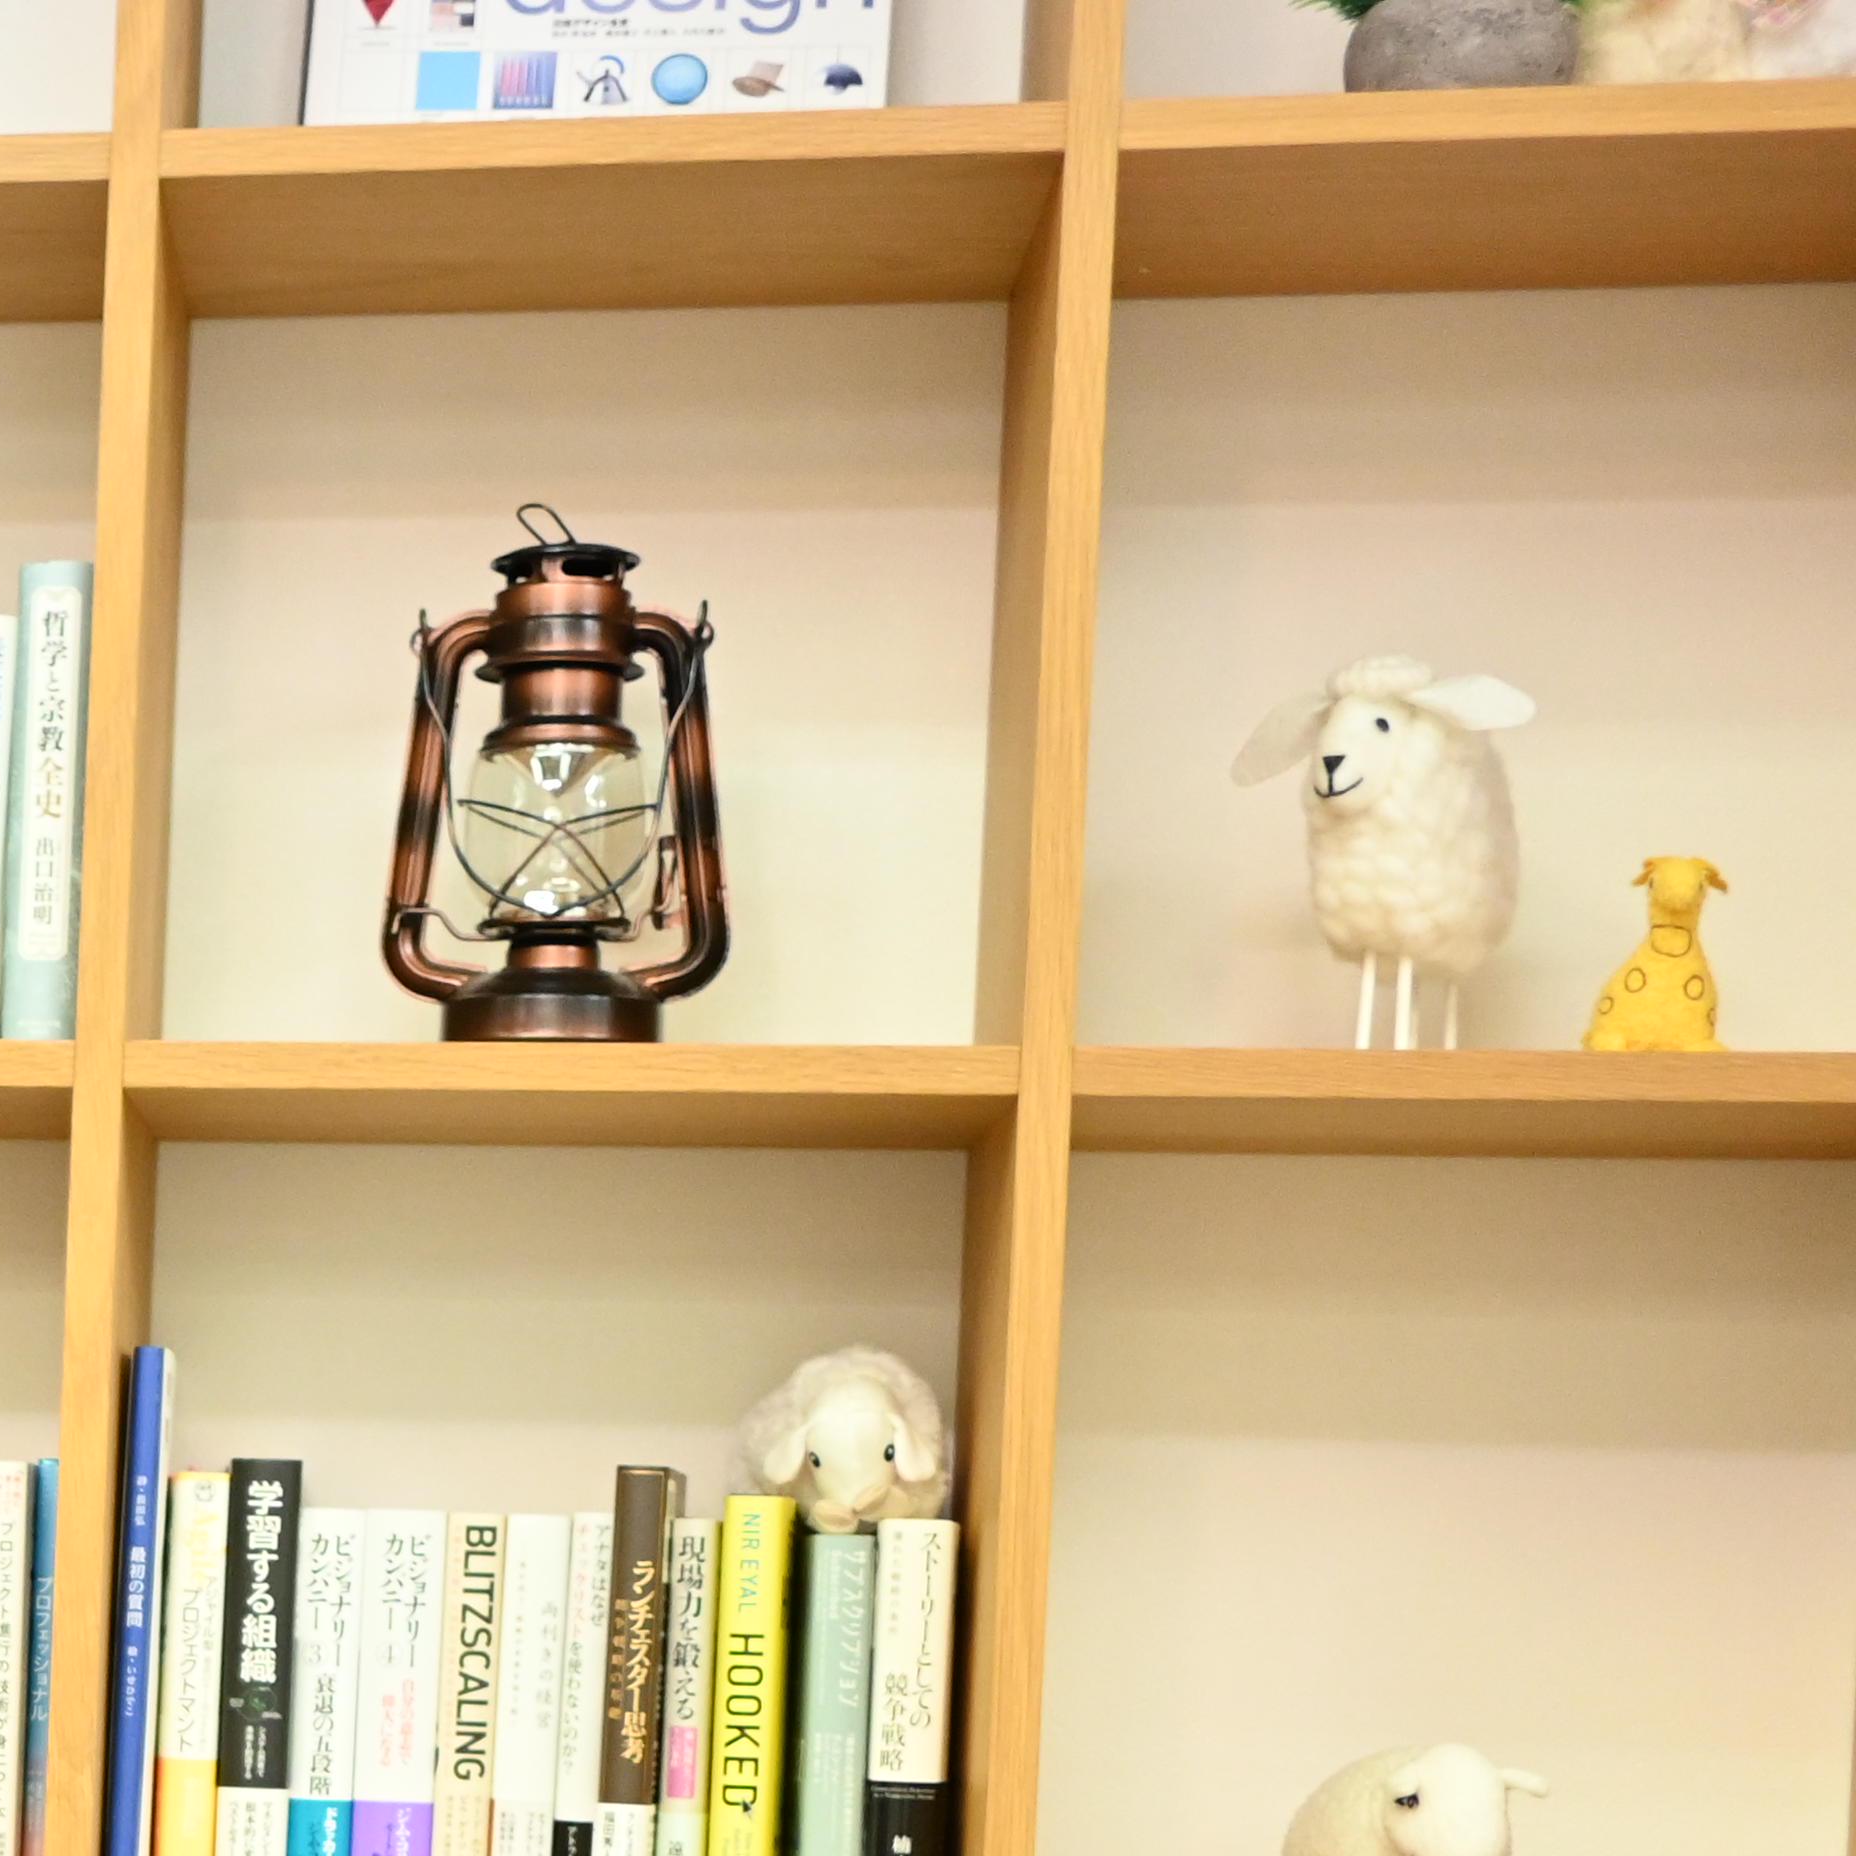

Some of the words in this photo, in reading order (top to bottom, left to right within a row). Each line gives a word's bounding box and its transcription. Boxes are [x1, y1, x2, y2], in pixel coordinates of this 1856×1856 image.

[35, 609, 70, 821] 哲学と宗教全史
[32, 835, 57, 927] 出口治明
[126, 1545, 148, 1629] 最初の質問
[239, 1479, 284, 1684] 学習する組織
[306, 1532, 331, 1632] カンパニー
[381, 1532, 406, 1632] カンパニー
[589, 1523, 612, 1628] アナタはなぜ
[736, 1558, 760, 1614] EYAL
[739, 1512, 761, 1551] NIR
[29, 1575, 54, 1722] プロフェッショナル
[328, 1532, 358, 1668] ビジョナリー
[402, 1532, 432, 1668] ビジョナリー
[453, 1523, 498, 1783] BLITZSCALING
[619, 1559, 656, 1766] ランチェスター思考
[672, 1535, 707, 1722] 現場力を鍛える
[837, 1548, 869, 1711] サブスクリプション
[908, 1532, 944, 1730] ストーリーとしての
[308, 1672, 338, 1797] 衰退の五段階
[720, 1632, 766, 1809] HOOKED
[878, 1672, 909, 1772] 競争戦略
